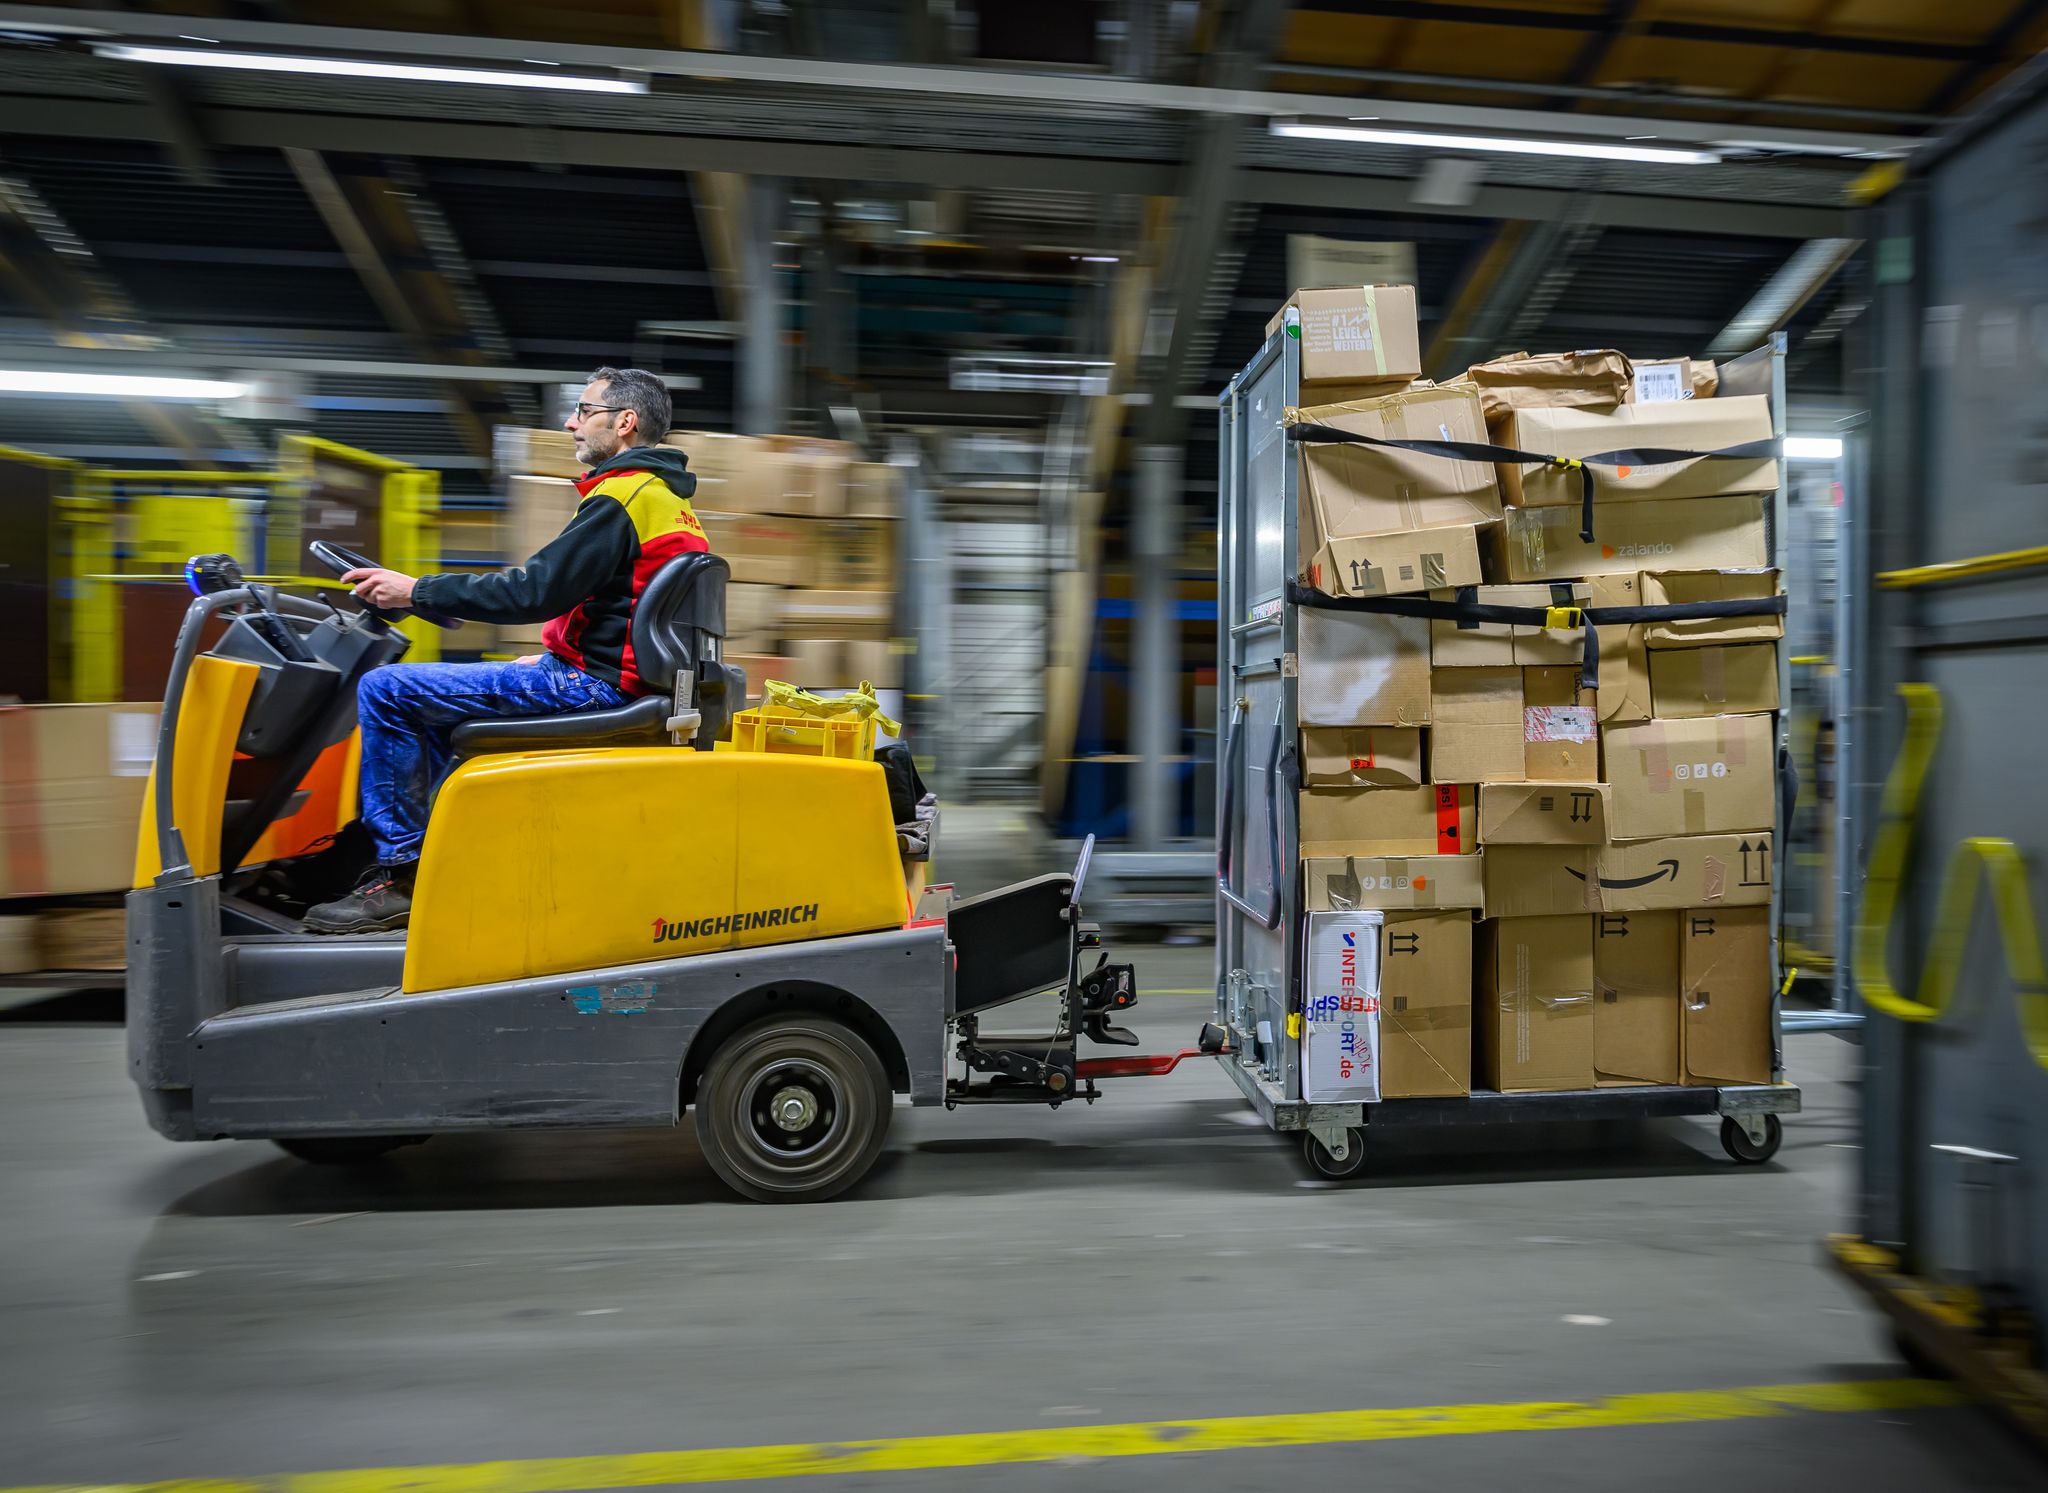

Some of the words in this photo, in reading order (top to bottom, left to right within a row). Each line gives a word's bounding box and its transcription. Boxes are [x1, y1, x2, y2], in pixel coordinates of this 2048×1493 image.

[1333, 326, 1362, 340] LEVEL
[1618, 541, 1674, 556] zalando
[1441, 784, 1454, 808] as!
[652, 903, 819, 944] JUNGHEINRICH
[1340, 949, 1355, 1079] INTERPORT.de
